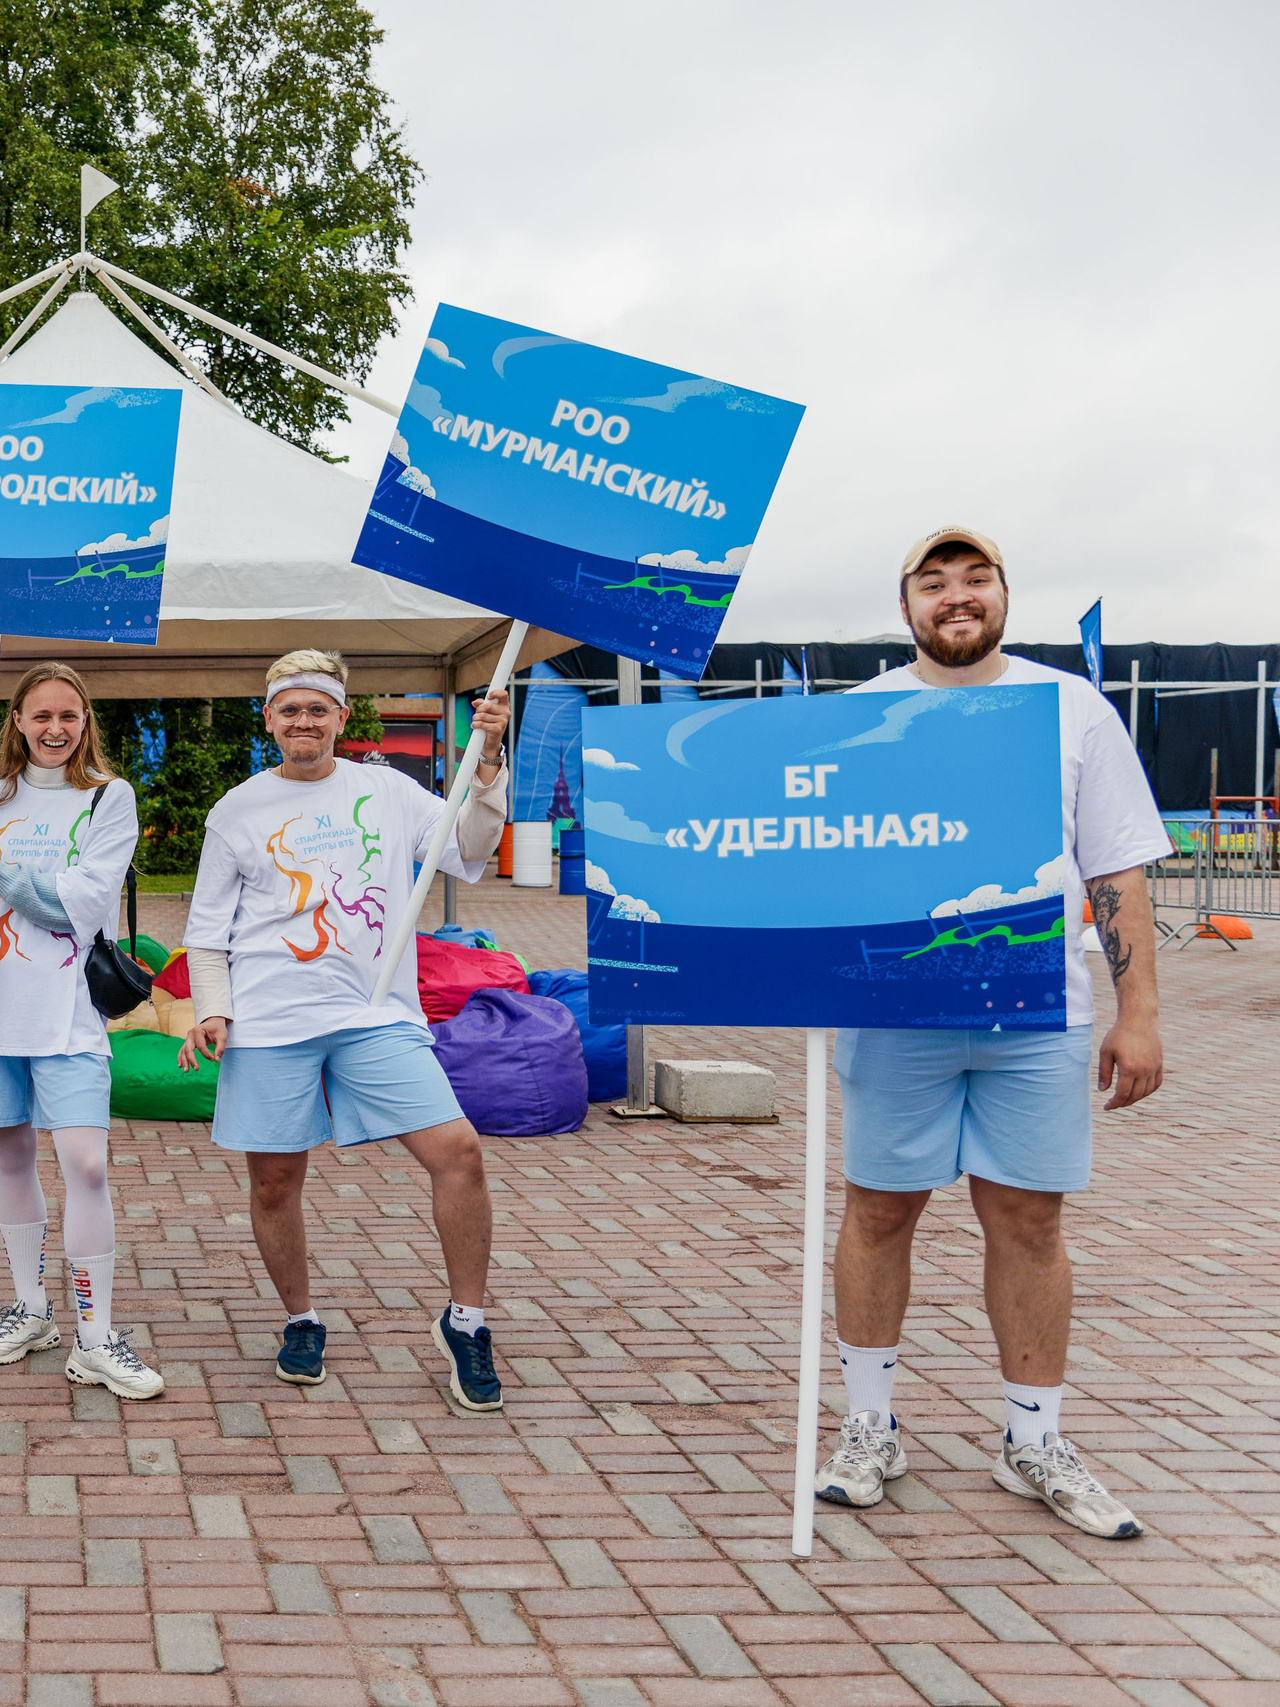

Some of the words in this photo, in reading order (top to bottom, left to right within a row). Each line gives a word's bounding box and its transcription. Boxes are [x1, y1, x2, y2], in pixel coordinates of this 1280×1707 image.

[551, 399, 630, 445] РОО
[432, 414, 726, 520] «МУРМАНСКИЙ»
[784, 764, 838, 798] БГ
[32, 823, 50, 836] XI
[315, 814, 332, 830] XI
[8, 838, 67, 846] СПАРТАКИАДА
[294, 827, 357, 845] СПАРТАКИАДА
[664, 812, 969, 858] «УДЕЛЬНАЯ»
[44, 849, 60, 858] ВТБ
[303, 842, 337, 855] ГРУППЫ
[338, 838, 355, 848] ВТБ
